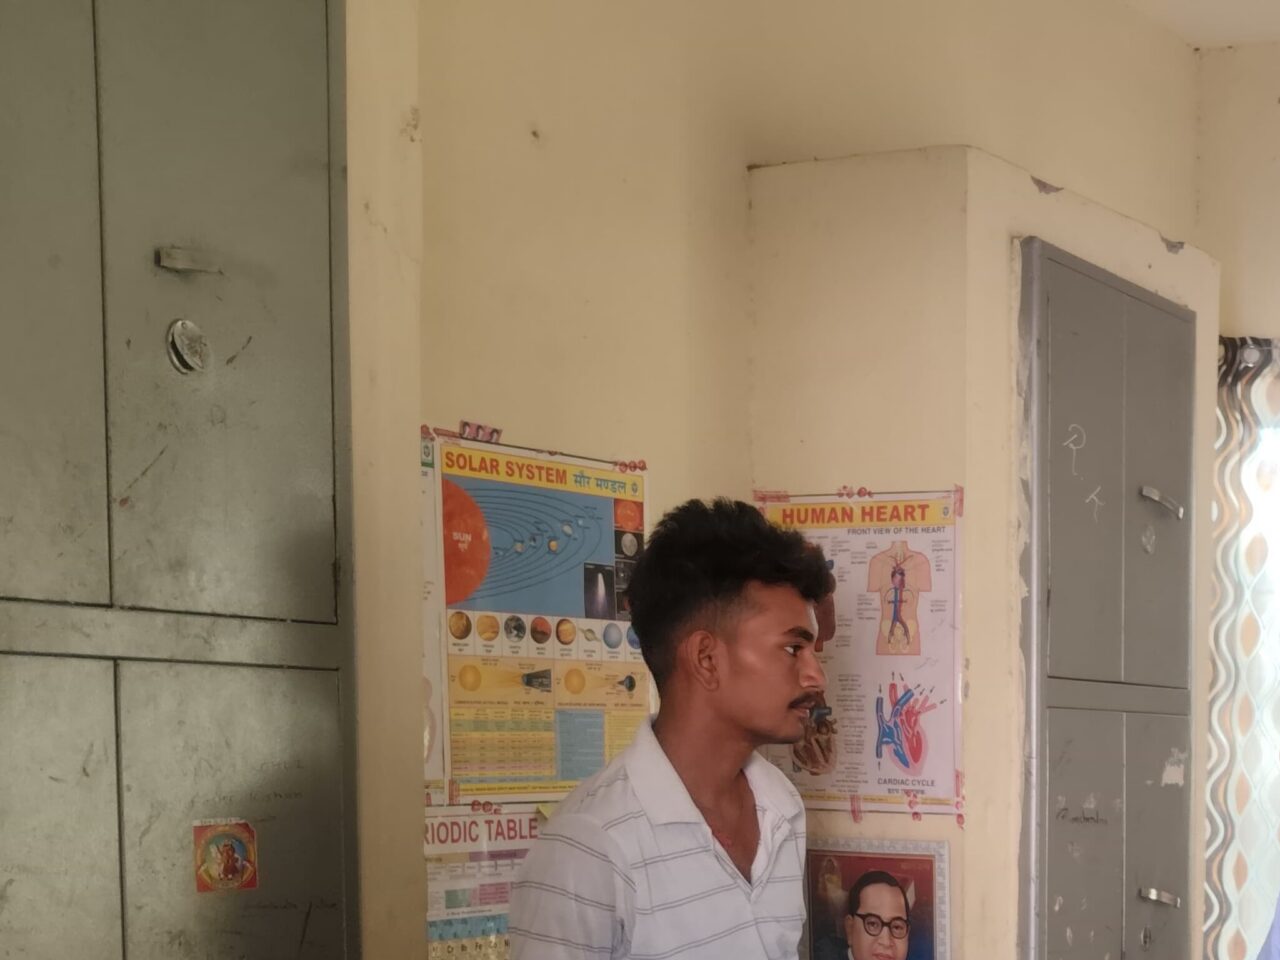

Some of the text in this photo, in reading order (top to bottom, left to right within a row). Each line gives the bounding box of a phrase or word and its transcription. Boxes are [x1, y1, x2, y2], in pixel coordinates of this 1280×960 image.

[445, 451, 567, 485] SOLAR SYSTEM
[782, 504, 930, 525] HUMAN HEART
[452, 532, 472, 541] SUN
[847, 526, 946, 536] FRONT VIEW OF THE HEART
[877, 777, 935, 787] CARDIAC CYCLE
[484, 818, 539, 842] TABLE
